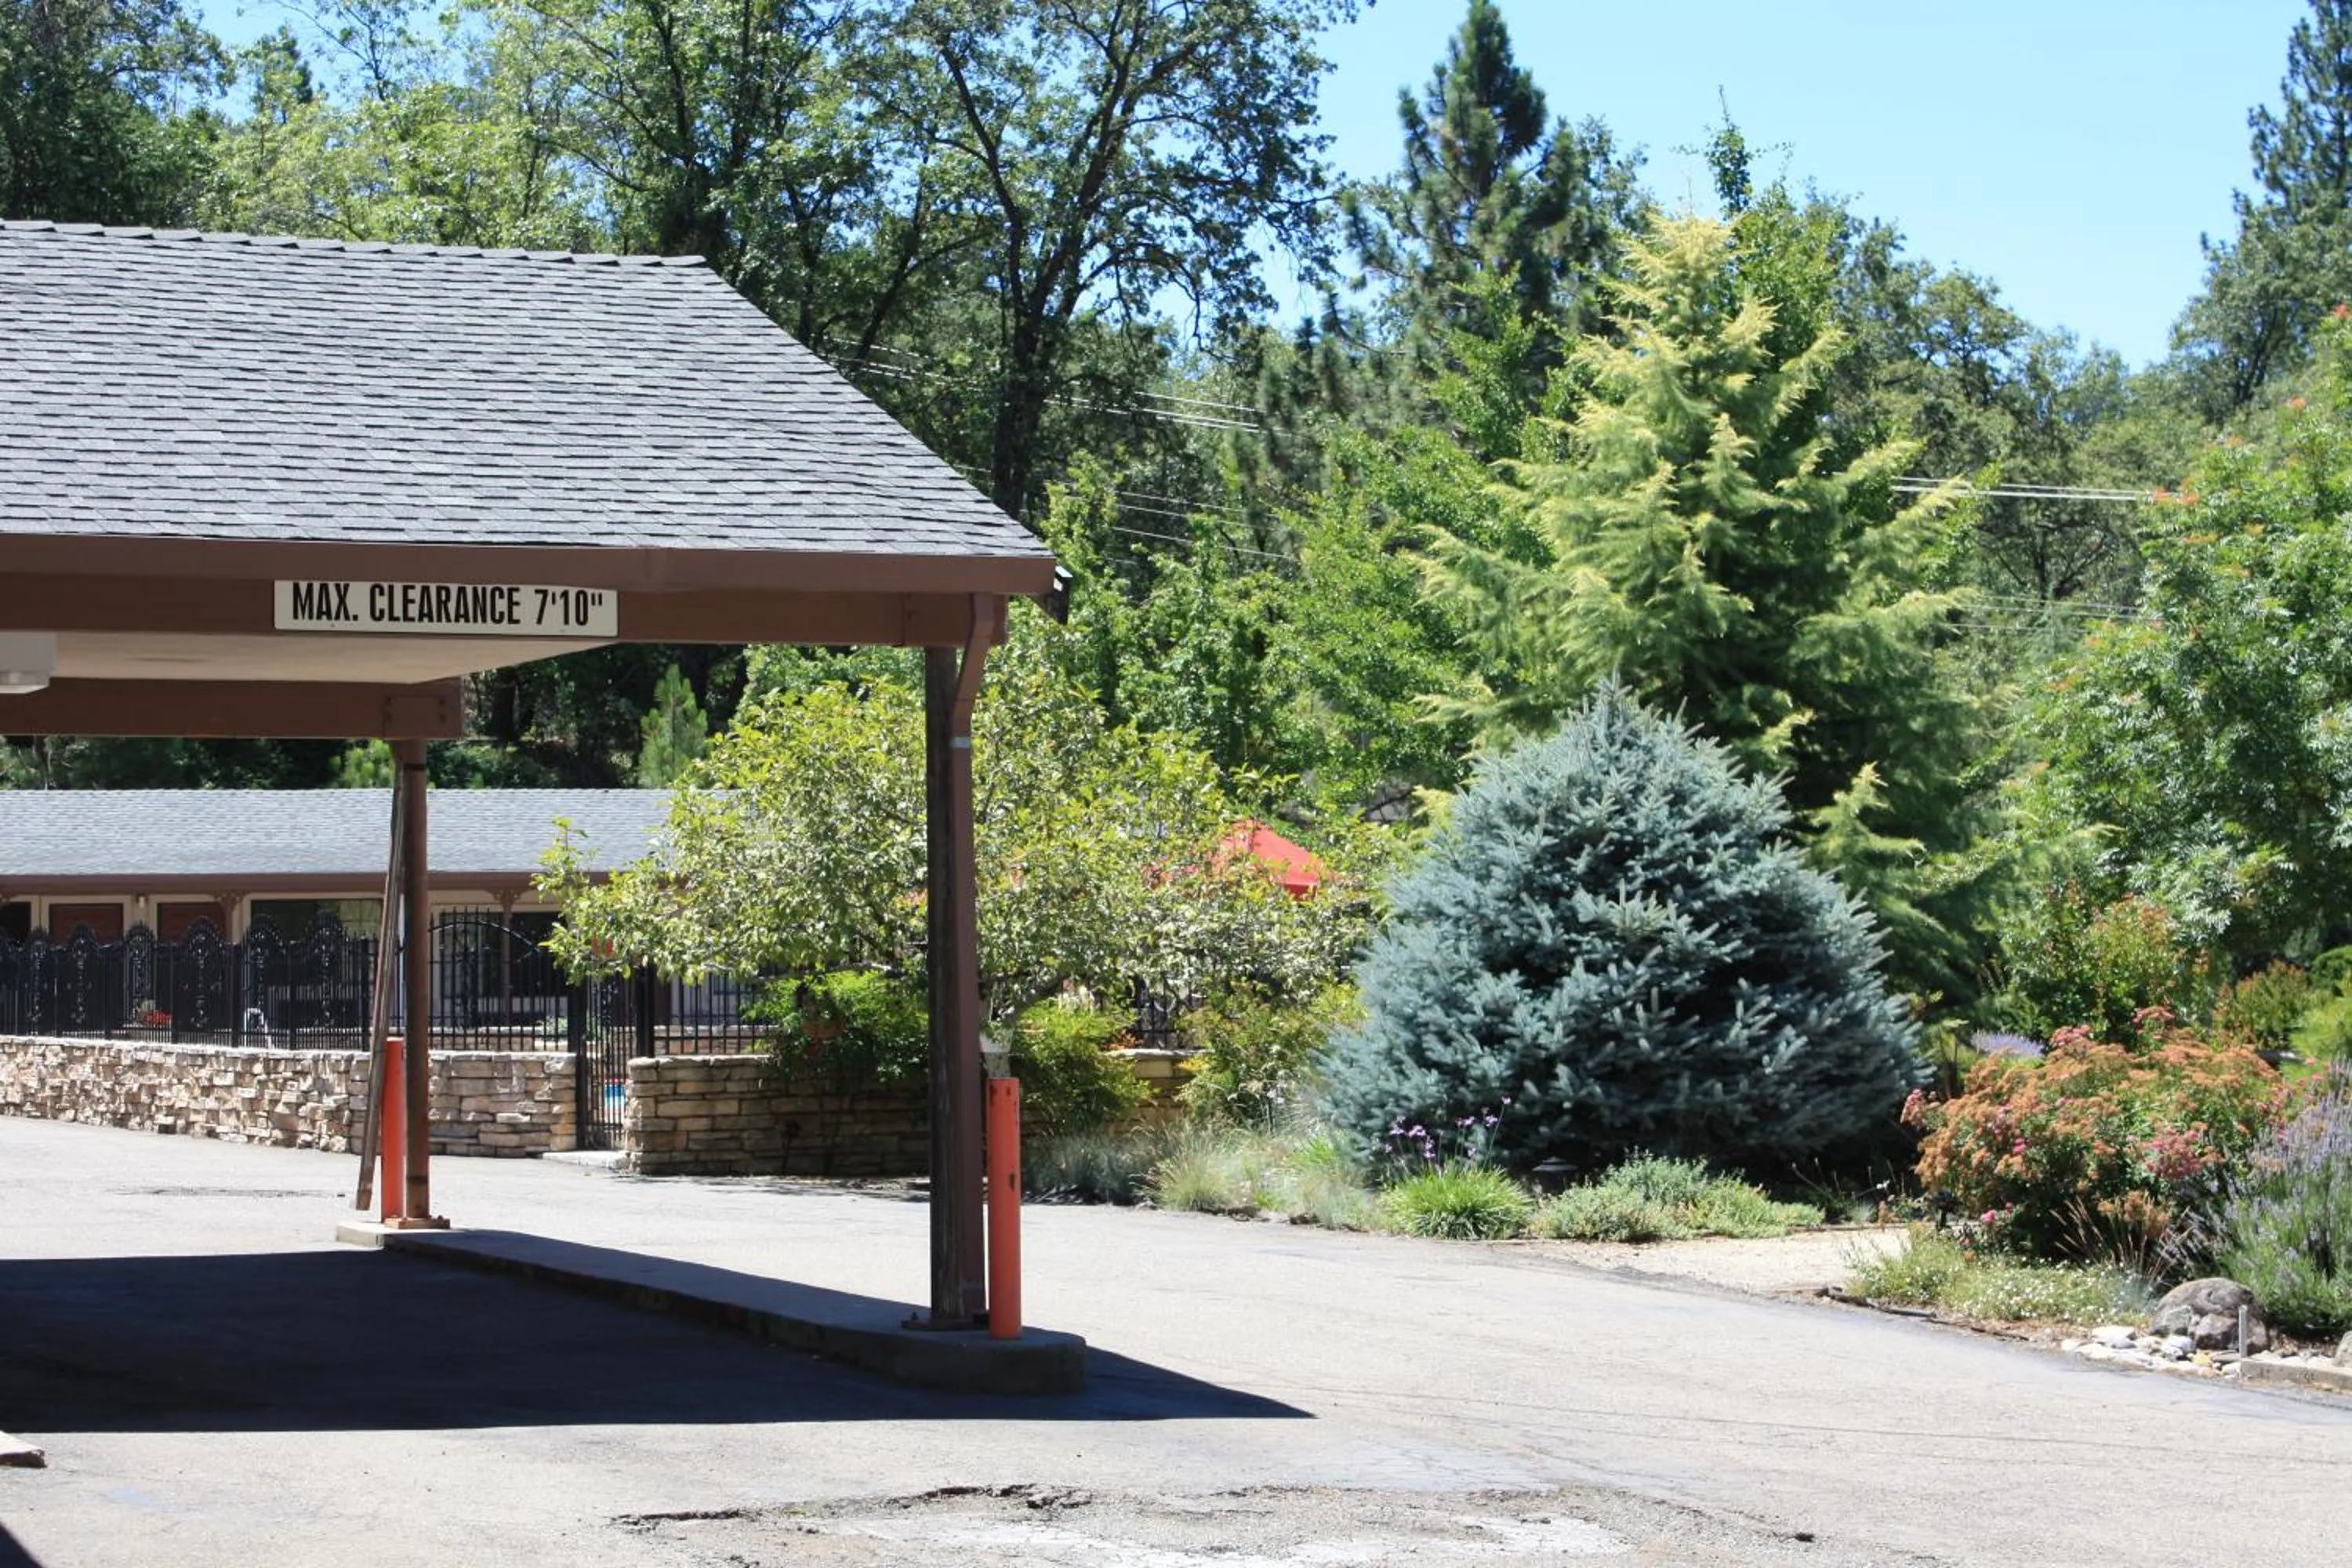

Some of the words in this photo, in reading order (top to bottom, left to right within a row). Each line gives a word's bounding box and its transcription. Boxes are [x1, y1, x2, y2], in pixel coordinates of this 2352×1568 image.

[292, 582, 358, 621] MAX.
[369, 583, 521, 624] CLEARANCE
[534, 589, 602, 626] 7'10"
